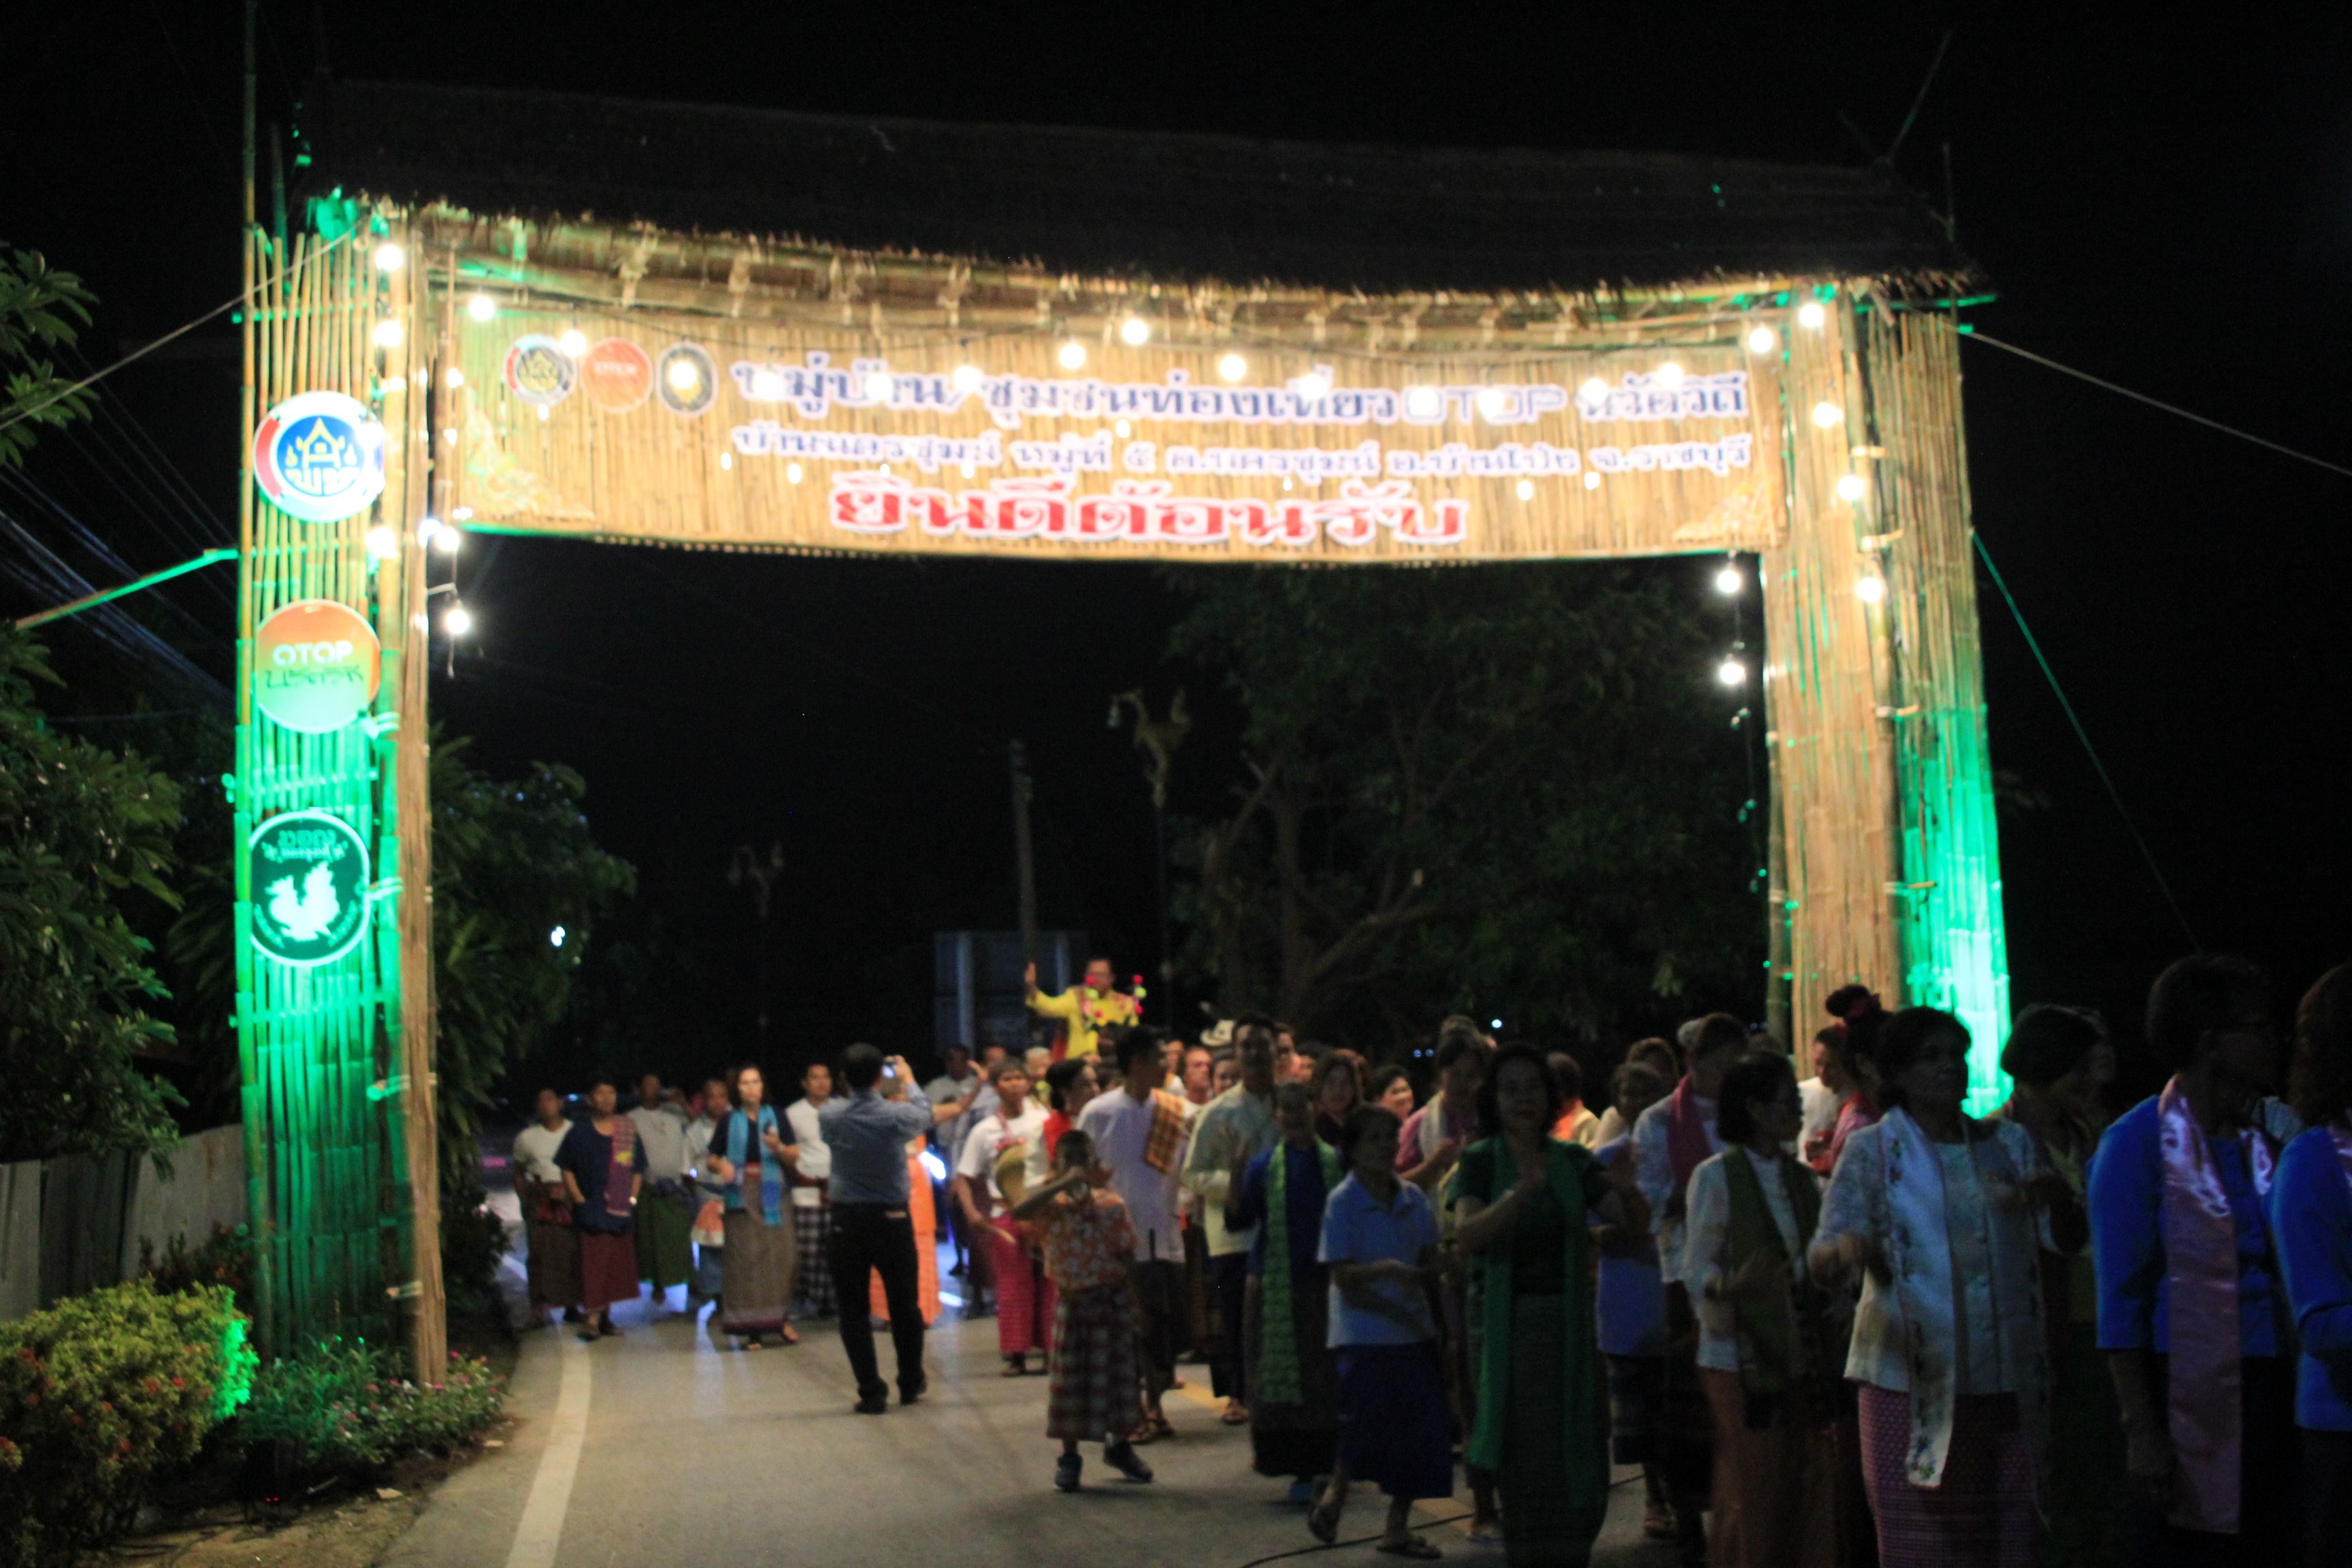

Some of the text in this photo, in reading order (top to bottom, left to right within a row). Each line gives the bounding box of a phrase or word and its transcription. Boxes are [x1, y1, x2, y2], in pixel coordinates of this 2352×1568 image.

[1406, 387, 1565, 422] OTOP
[834, 472, 1467, 542] ยินดีต้อนรับ
[273, 640, 353, 666] OTOP
